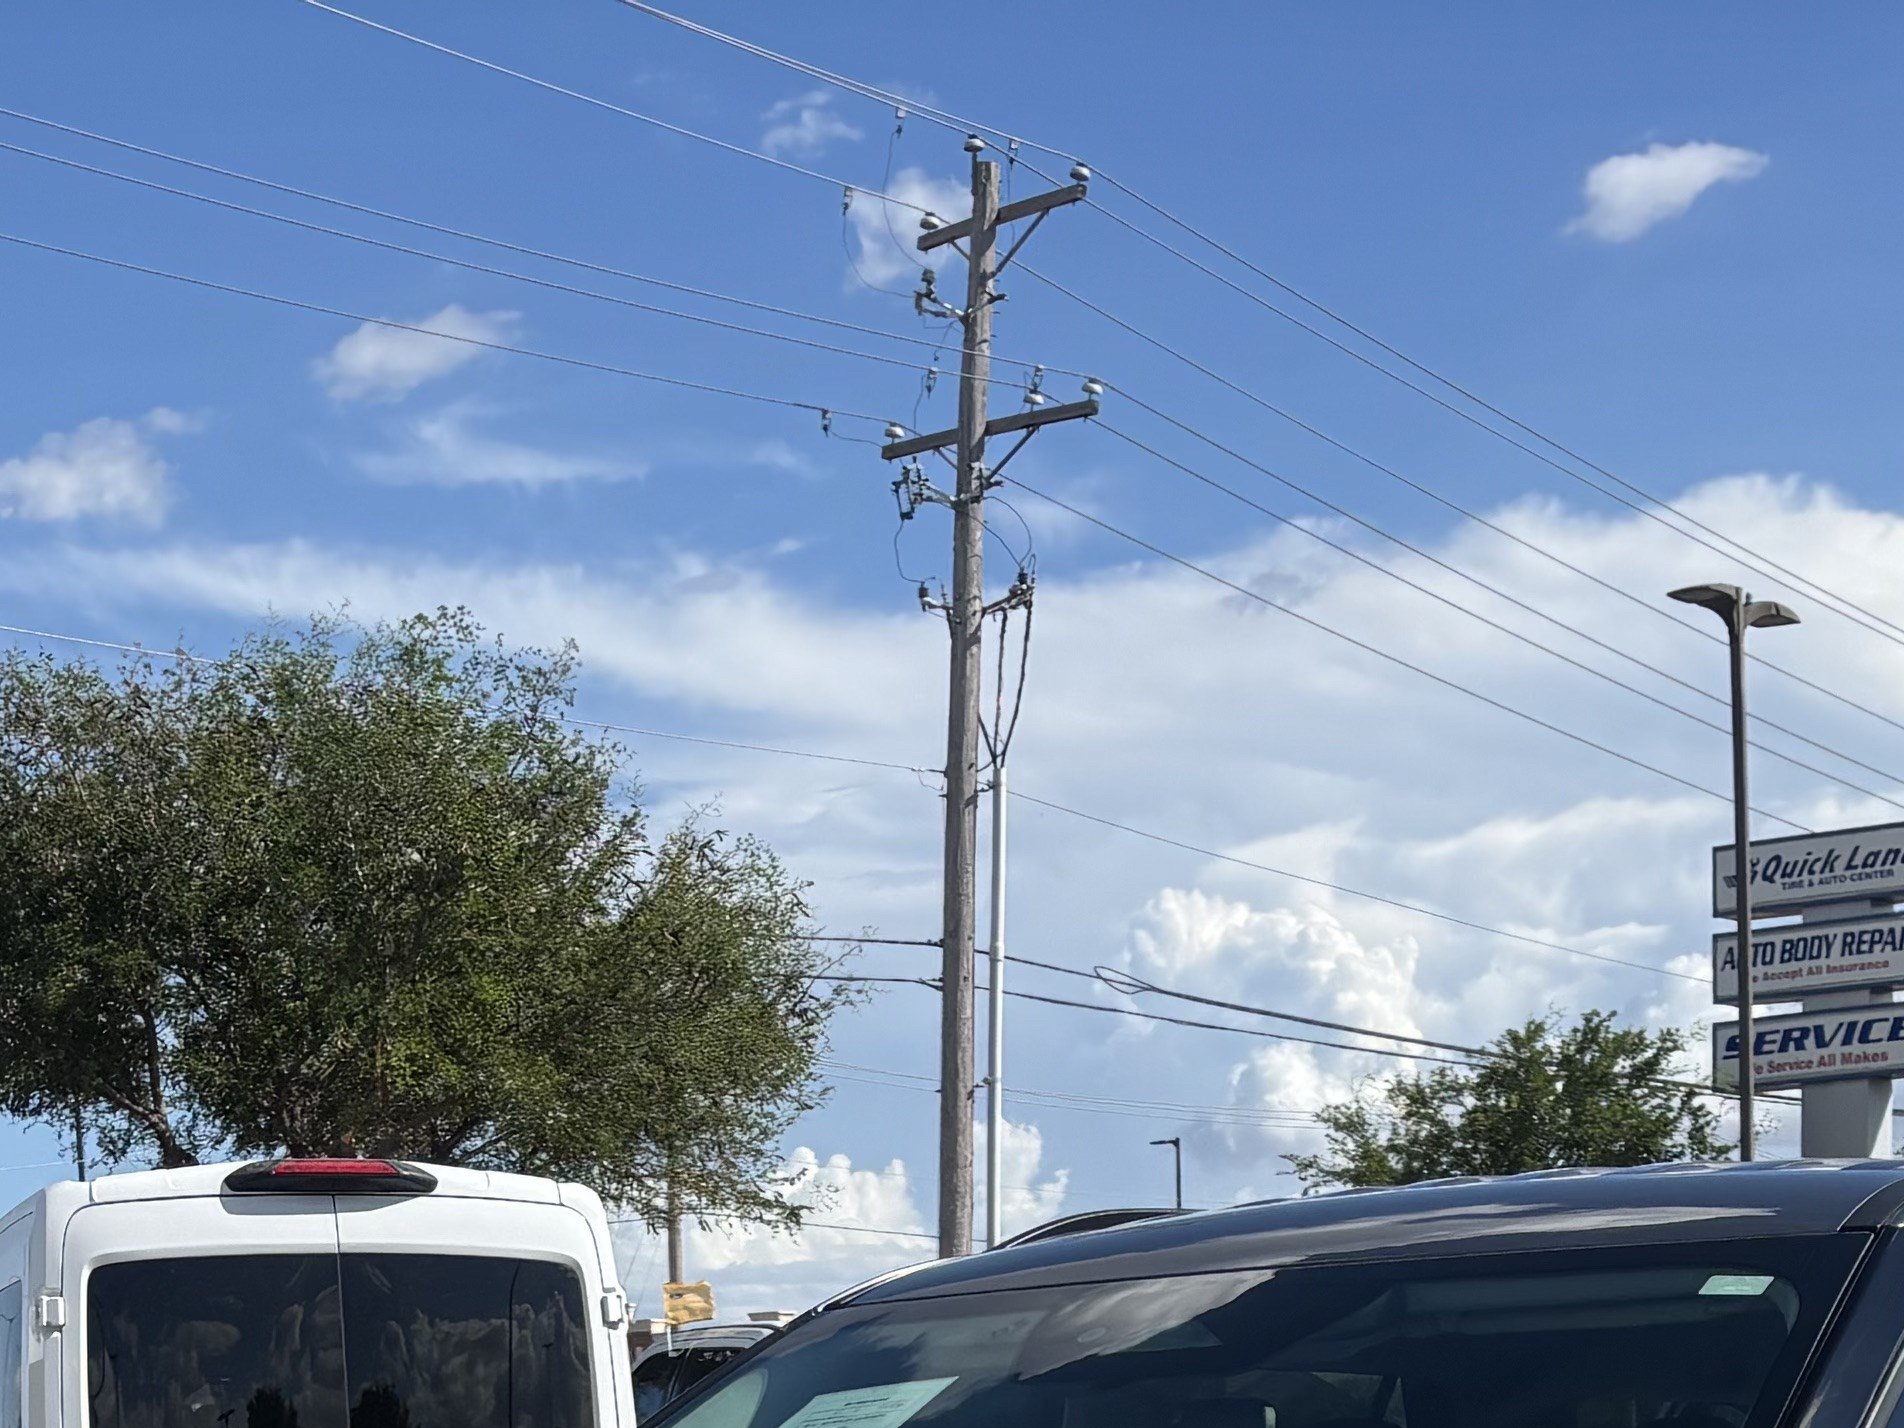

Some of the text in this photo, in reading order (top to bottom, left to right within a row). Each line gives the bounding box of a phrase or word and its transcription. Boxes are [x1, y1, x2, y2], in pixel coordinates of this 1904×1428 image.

[1760, 848, 1842, 884] Quick
[1780, 867, 1895, 891] TIRE & AUTO CENTER
[1721, 940, 1776, 972] ATO
[1779, 932, 1838, 964] BODY
[1762, 966, 1804, 983] Accept
[1806, 963, 1824, 978] All
[1825, 959, 1890, 975] Insurance
[1766, 1055, 1815, 1074] Service
[1816, 1051, 1837, 1068] All
[1840, 1050, 1889, 1067] Makes
